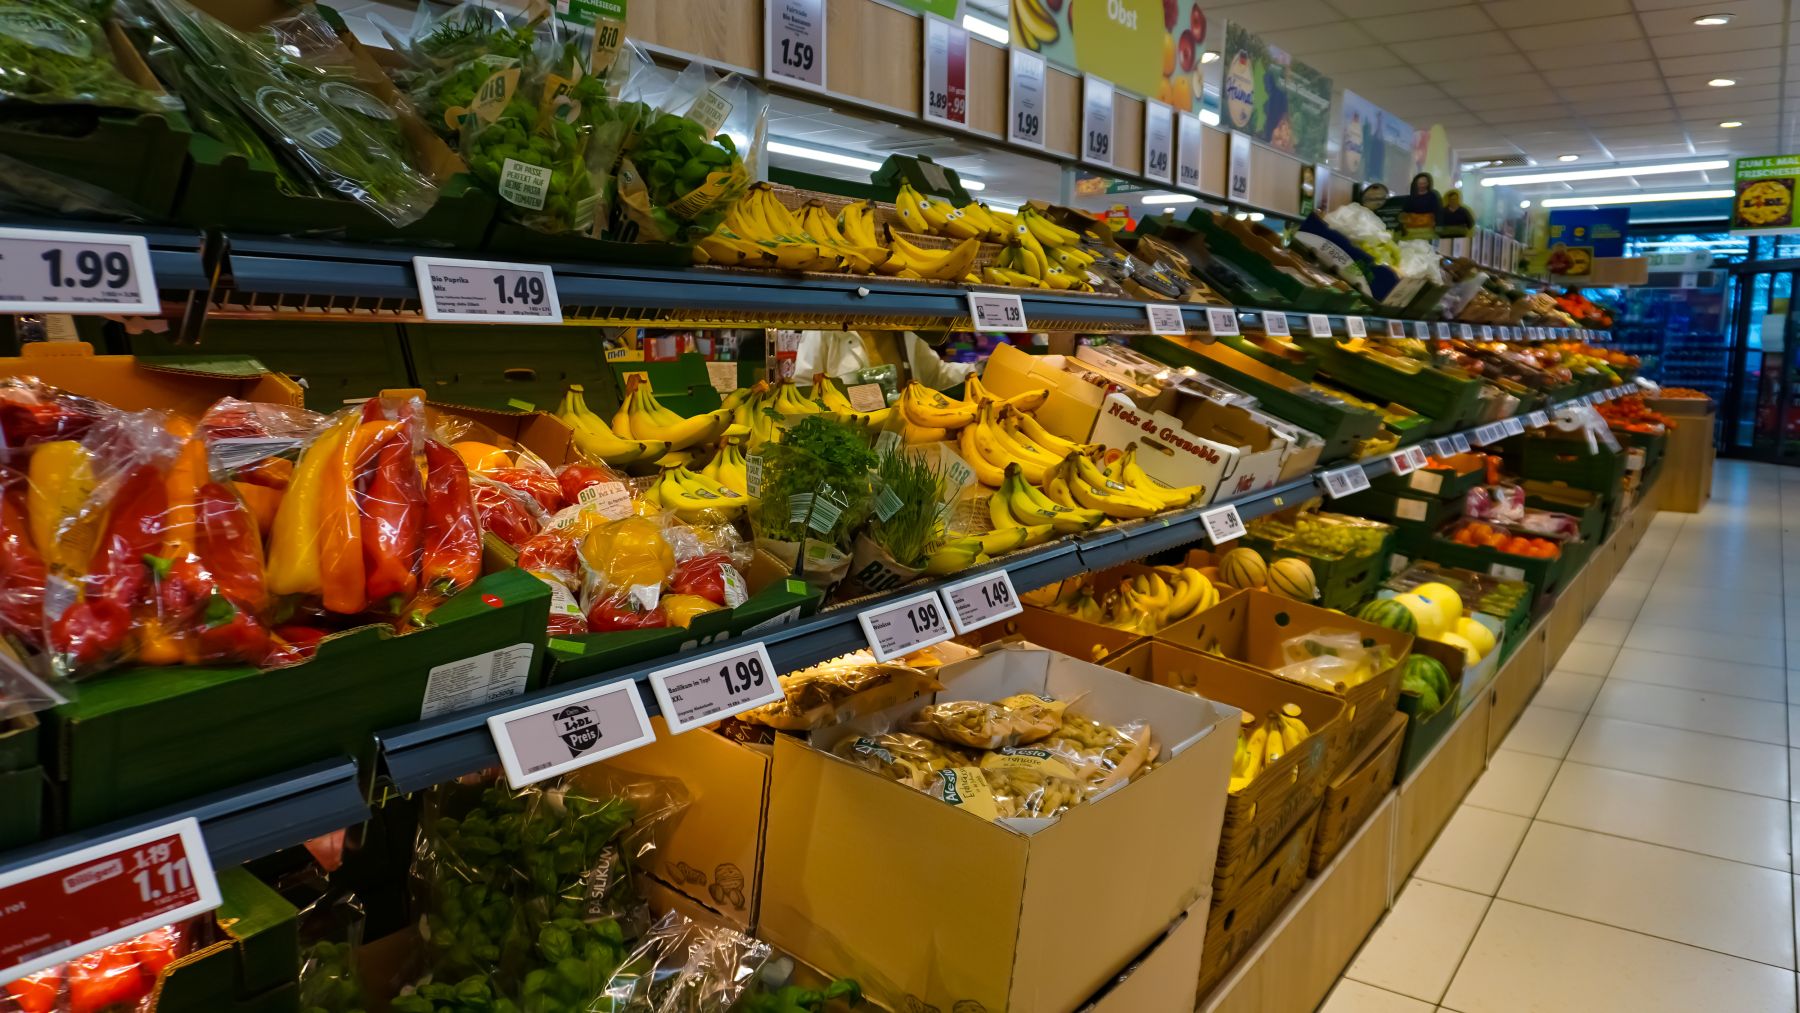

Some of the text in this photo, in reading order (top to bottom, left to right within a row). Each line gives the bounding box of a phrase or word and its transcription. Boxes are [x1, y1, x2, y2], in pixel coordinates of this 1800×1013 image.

[1107, 0, 1137, 30] Obst
[781, 38, 814, 70] 1.59
[1017, 111, 1039, 136] 1.99
[1089, 130, 1109, 154] 1.99
[524, 165, 543, 177] PASSE
[1150, 149, 1168, 171] 2.49
[506, 170, 531, 183] PERFEKT
[40, 248, 130, 289] 1.99
[444, 276, 469, 284] Paprika
[433, 284, 446, 292] Mix
[493, 274, 545, 305] 1.49
[1004, 306, 1020, 321] 1.39
[1108, 402, 1220, 464] Noix de Grenoble
[981, 580, 1010, 608] 1.49
[907, 603, 940, 634] 1.99
[668, 682, 693, 694] Basilikum
[719, 657, 764, 695] 1.99
[671, 694, 684, 703] XXL
[570, 729, 597, 748] Preis
[132, 856, 191, 902] 1.11
